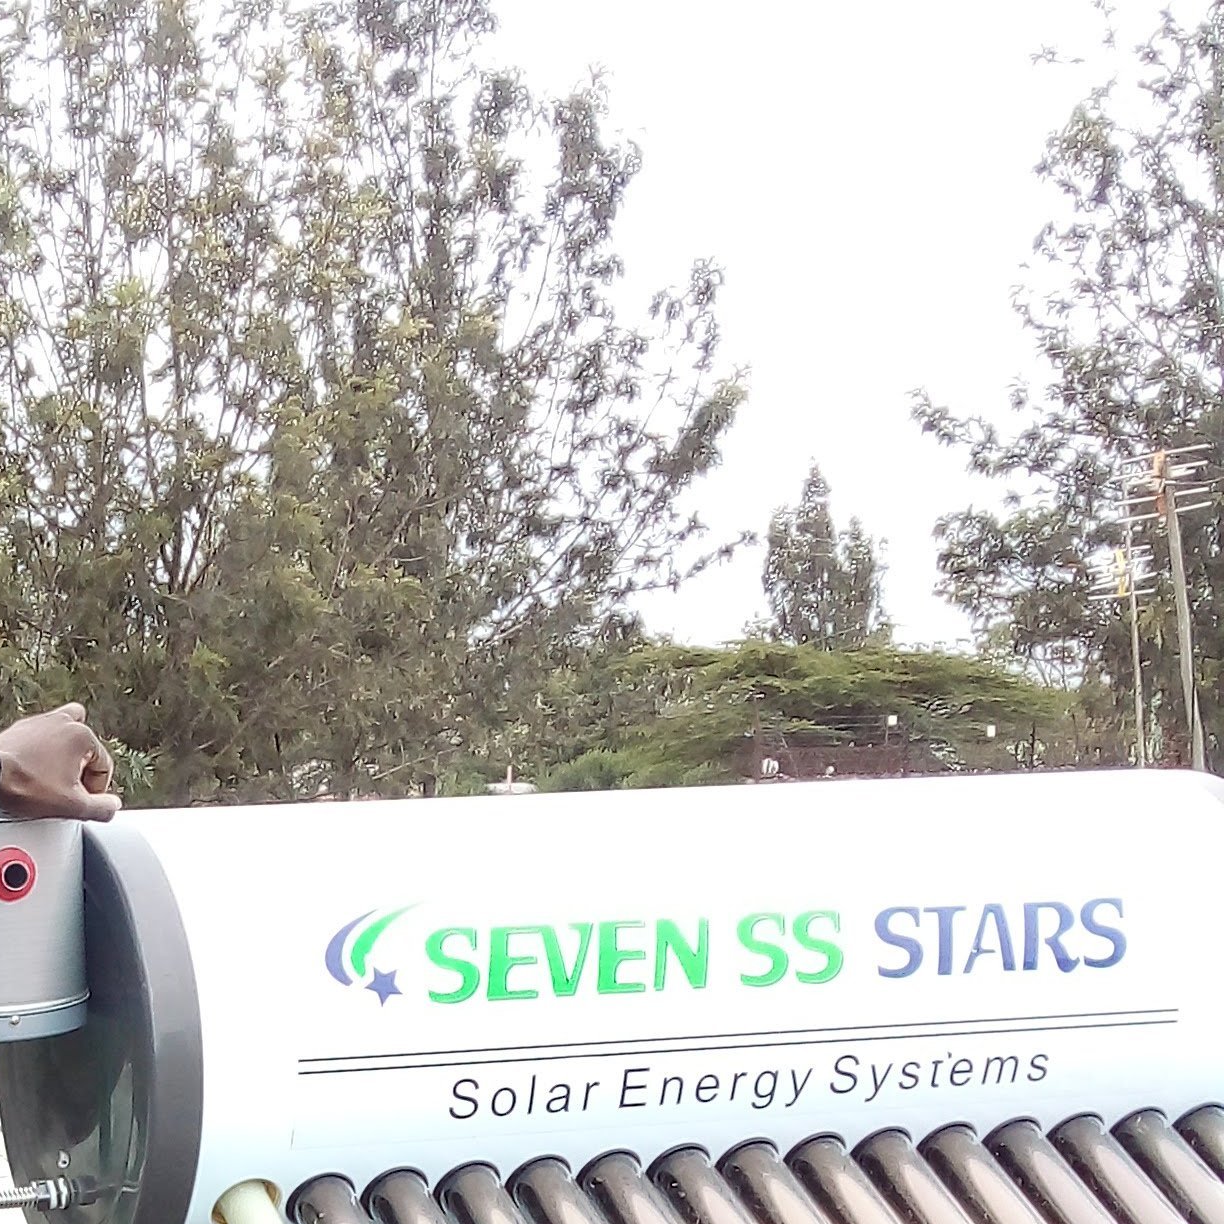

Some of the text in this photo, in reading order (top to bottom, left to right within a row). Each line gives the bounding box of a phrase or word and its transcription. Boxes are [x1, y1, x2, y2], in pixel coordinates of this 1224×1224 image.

[426, 898, 1128, 1005] SEVEN SS STARS
[448, 1052, 1049, 1120] Solar Energy Systems
